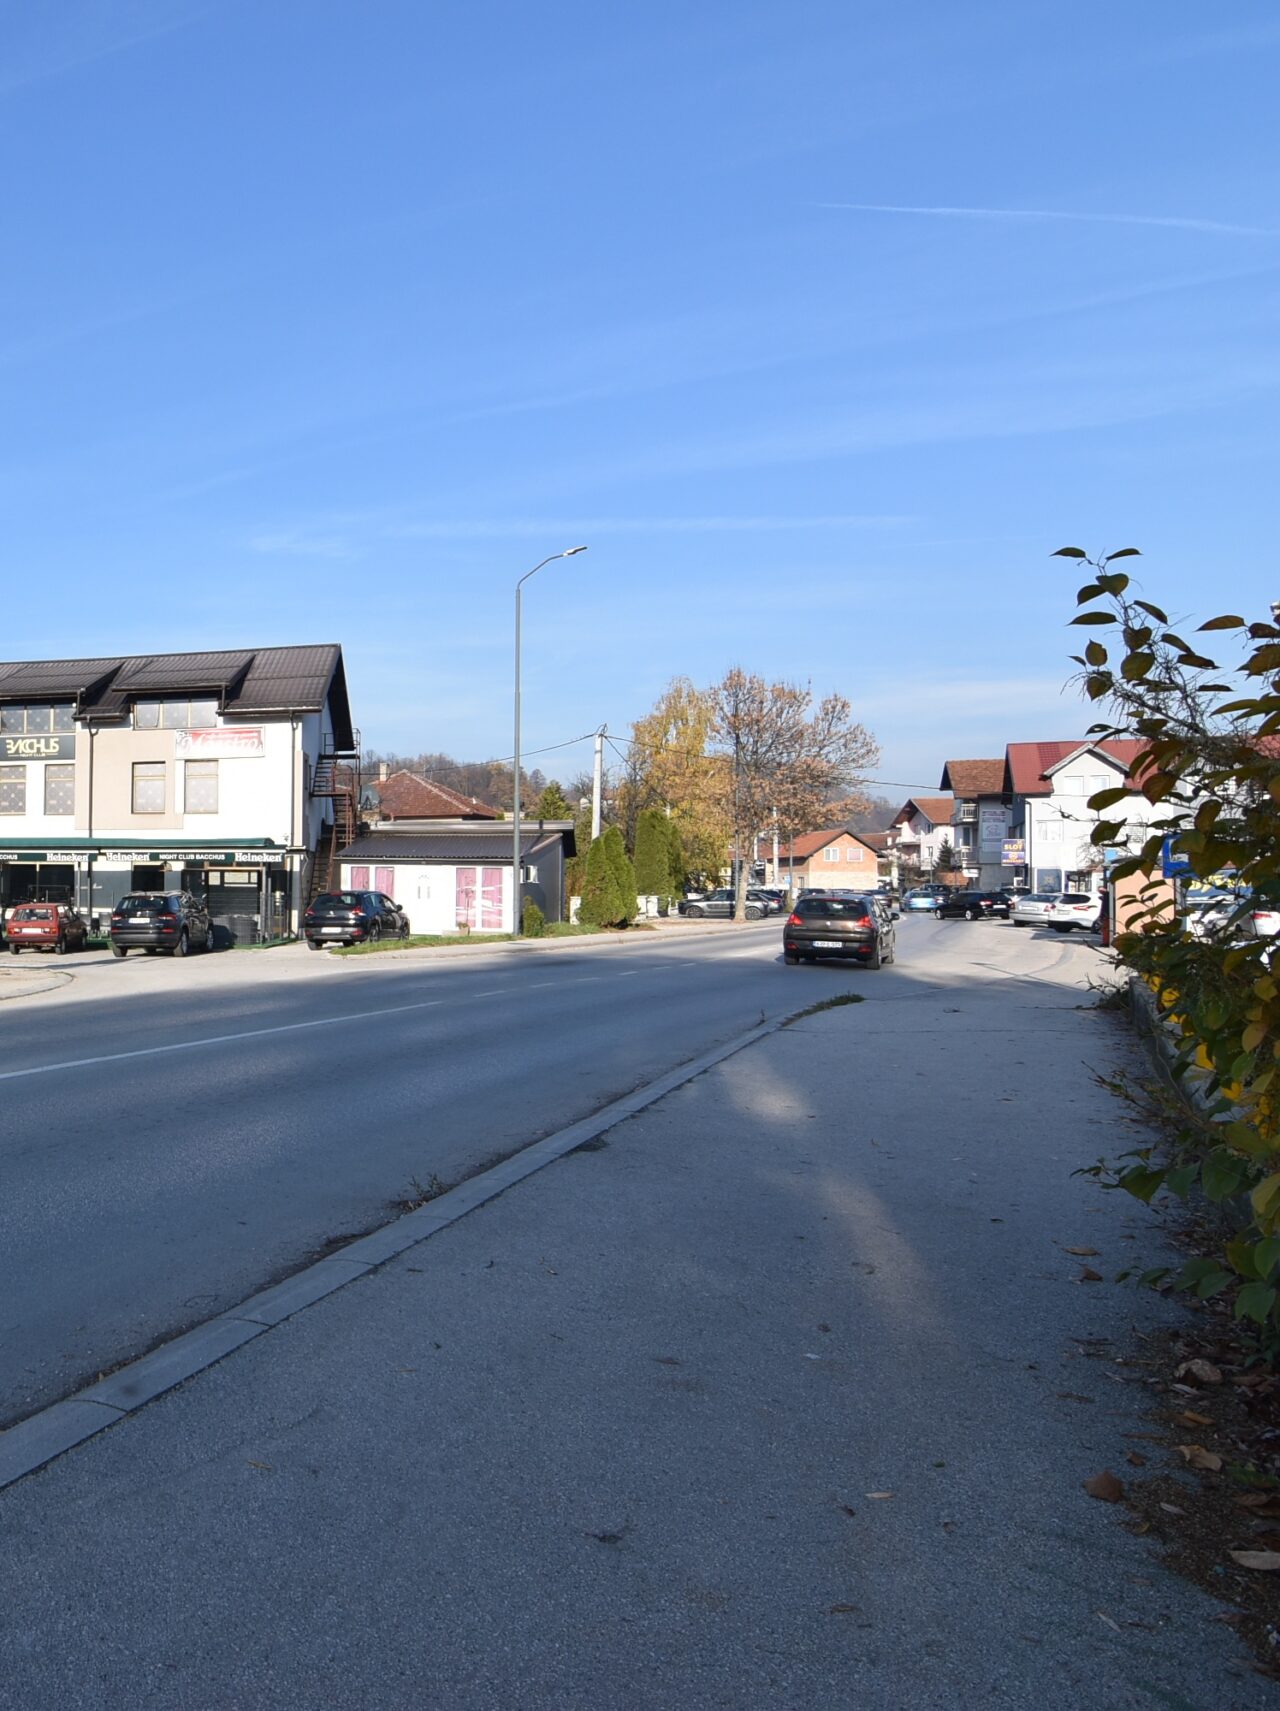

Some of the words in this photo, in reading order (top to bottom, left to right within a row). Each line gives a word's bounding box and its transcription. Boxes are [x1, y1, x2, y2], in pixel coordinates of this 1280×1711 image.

[6, 737, 60, 754] BACCHUS
[46, 852, 88, 862] Heineken
[107, 852, 150, 862] Heineken
[235, 852, 282, 862] Heineken
